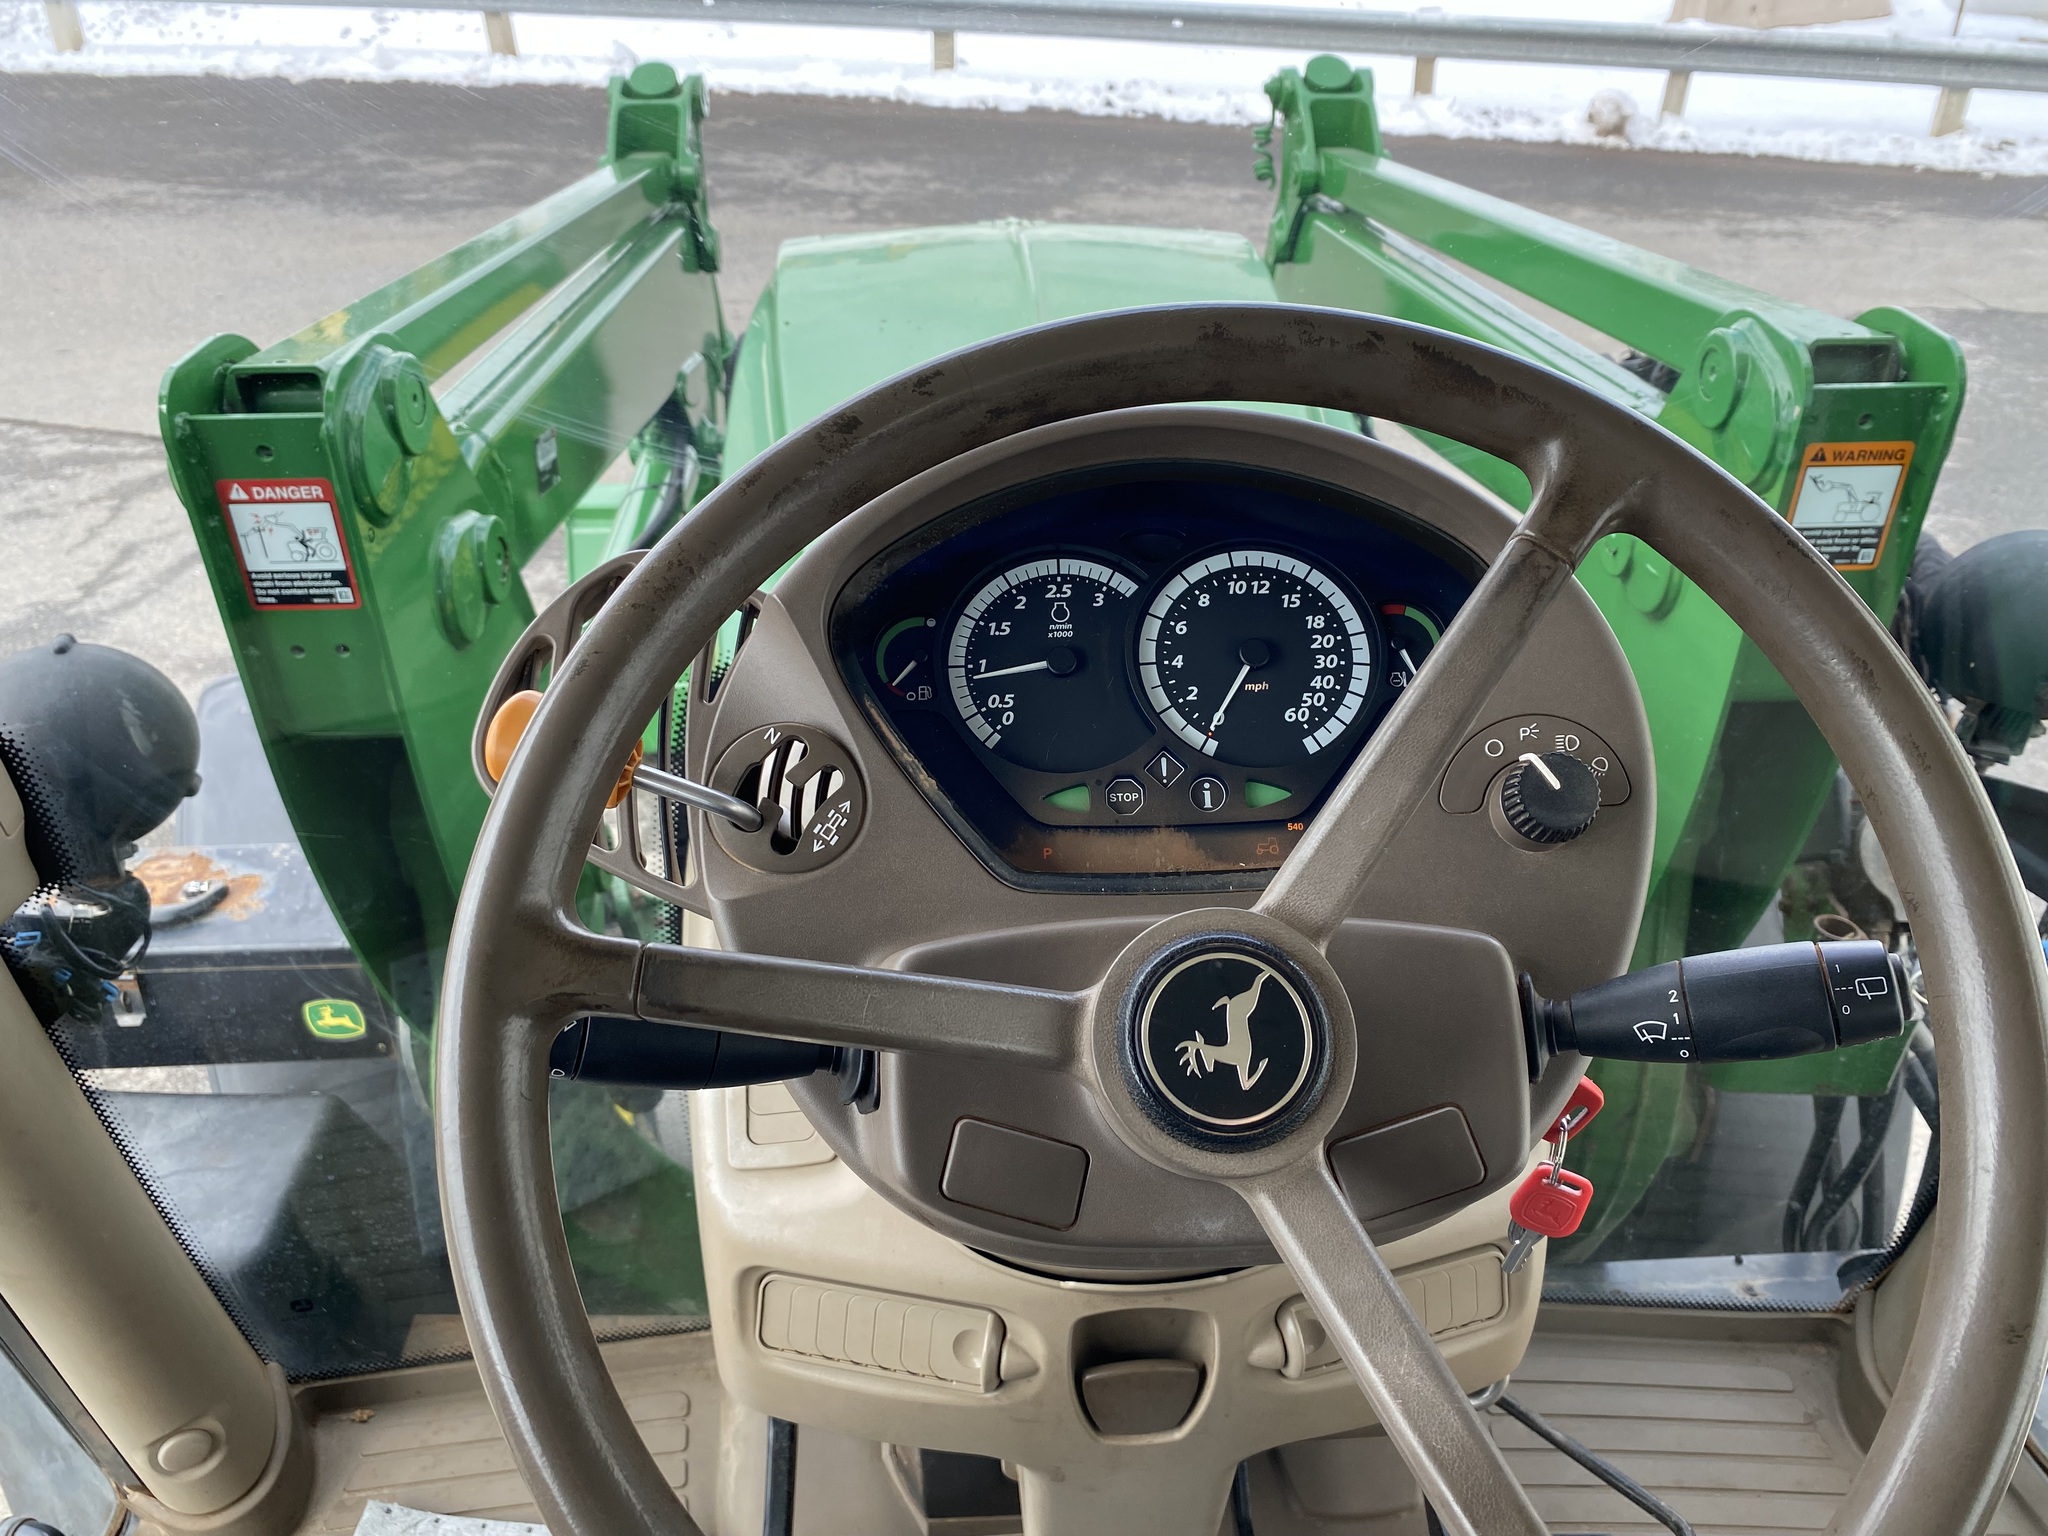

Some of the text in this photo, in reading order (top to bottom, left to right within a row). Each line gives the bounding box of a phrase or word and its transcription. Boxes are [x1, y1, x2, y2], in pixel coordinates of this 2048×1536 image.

[1832, 449, 1906, 461] WARNING
[252, 485, 324, 500] DANGER
[251, 572, 272, 580] Avoid
[301, 572, 322, 581] injury
[1045, 584, 1072, 598] 2.5
[1227, 580, 1247, 595] 10
[1250, 580, 1270, 595] 12
[1014, 596, 1027, 609] 2
[1092, 593, 1105, 606] 3
[1197, 593, 1210, 607] 8
[1281, 593, 1301, 608] 15
[988, 621, 1011, 636] 1.5
[1049, 622, 1072, 630] n/min
[1175, 620, 1187, 635] 6
[1305, 615, 1325, 629] 18
[1310, 634, 1335, 649] 20
[978, 658, 987, 673] 1
[1171, 654, 1184, 668] 4
[1314, 654, 1338, 669] 30
[1245, 681, 1269, 692] mph
[1310, 675, 1335, 689] 40
[1186, 686, 1198, 700] 2
[1300, 692, 1325, 707] 50
[987, 693, 1015, 708] 0.5
[1002, 711, 1015, 725] 0
[1212, 711, 1225, 726] 0
[1284, 707, 1310, 722] 60
[763, 727, 782, 745] N
[1109, 793, 1139, 802] STOP
[1287, 822, 1304, 831] 540
[1043, 848, 1052, 859] P
[1834, 964, 1840, 973] 1
[1668, 989, 1679, 1003] 2
[1672, 1012, 1680, 1025] 1
